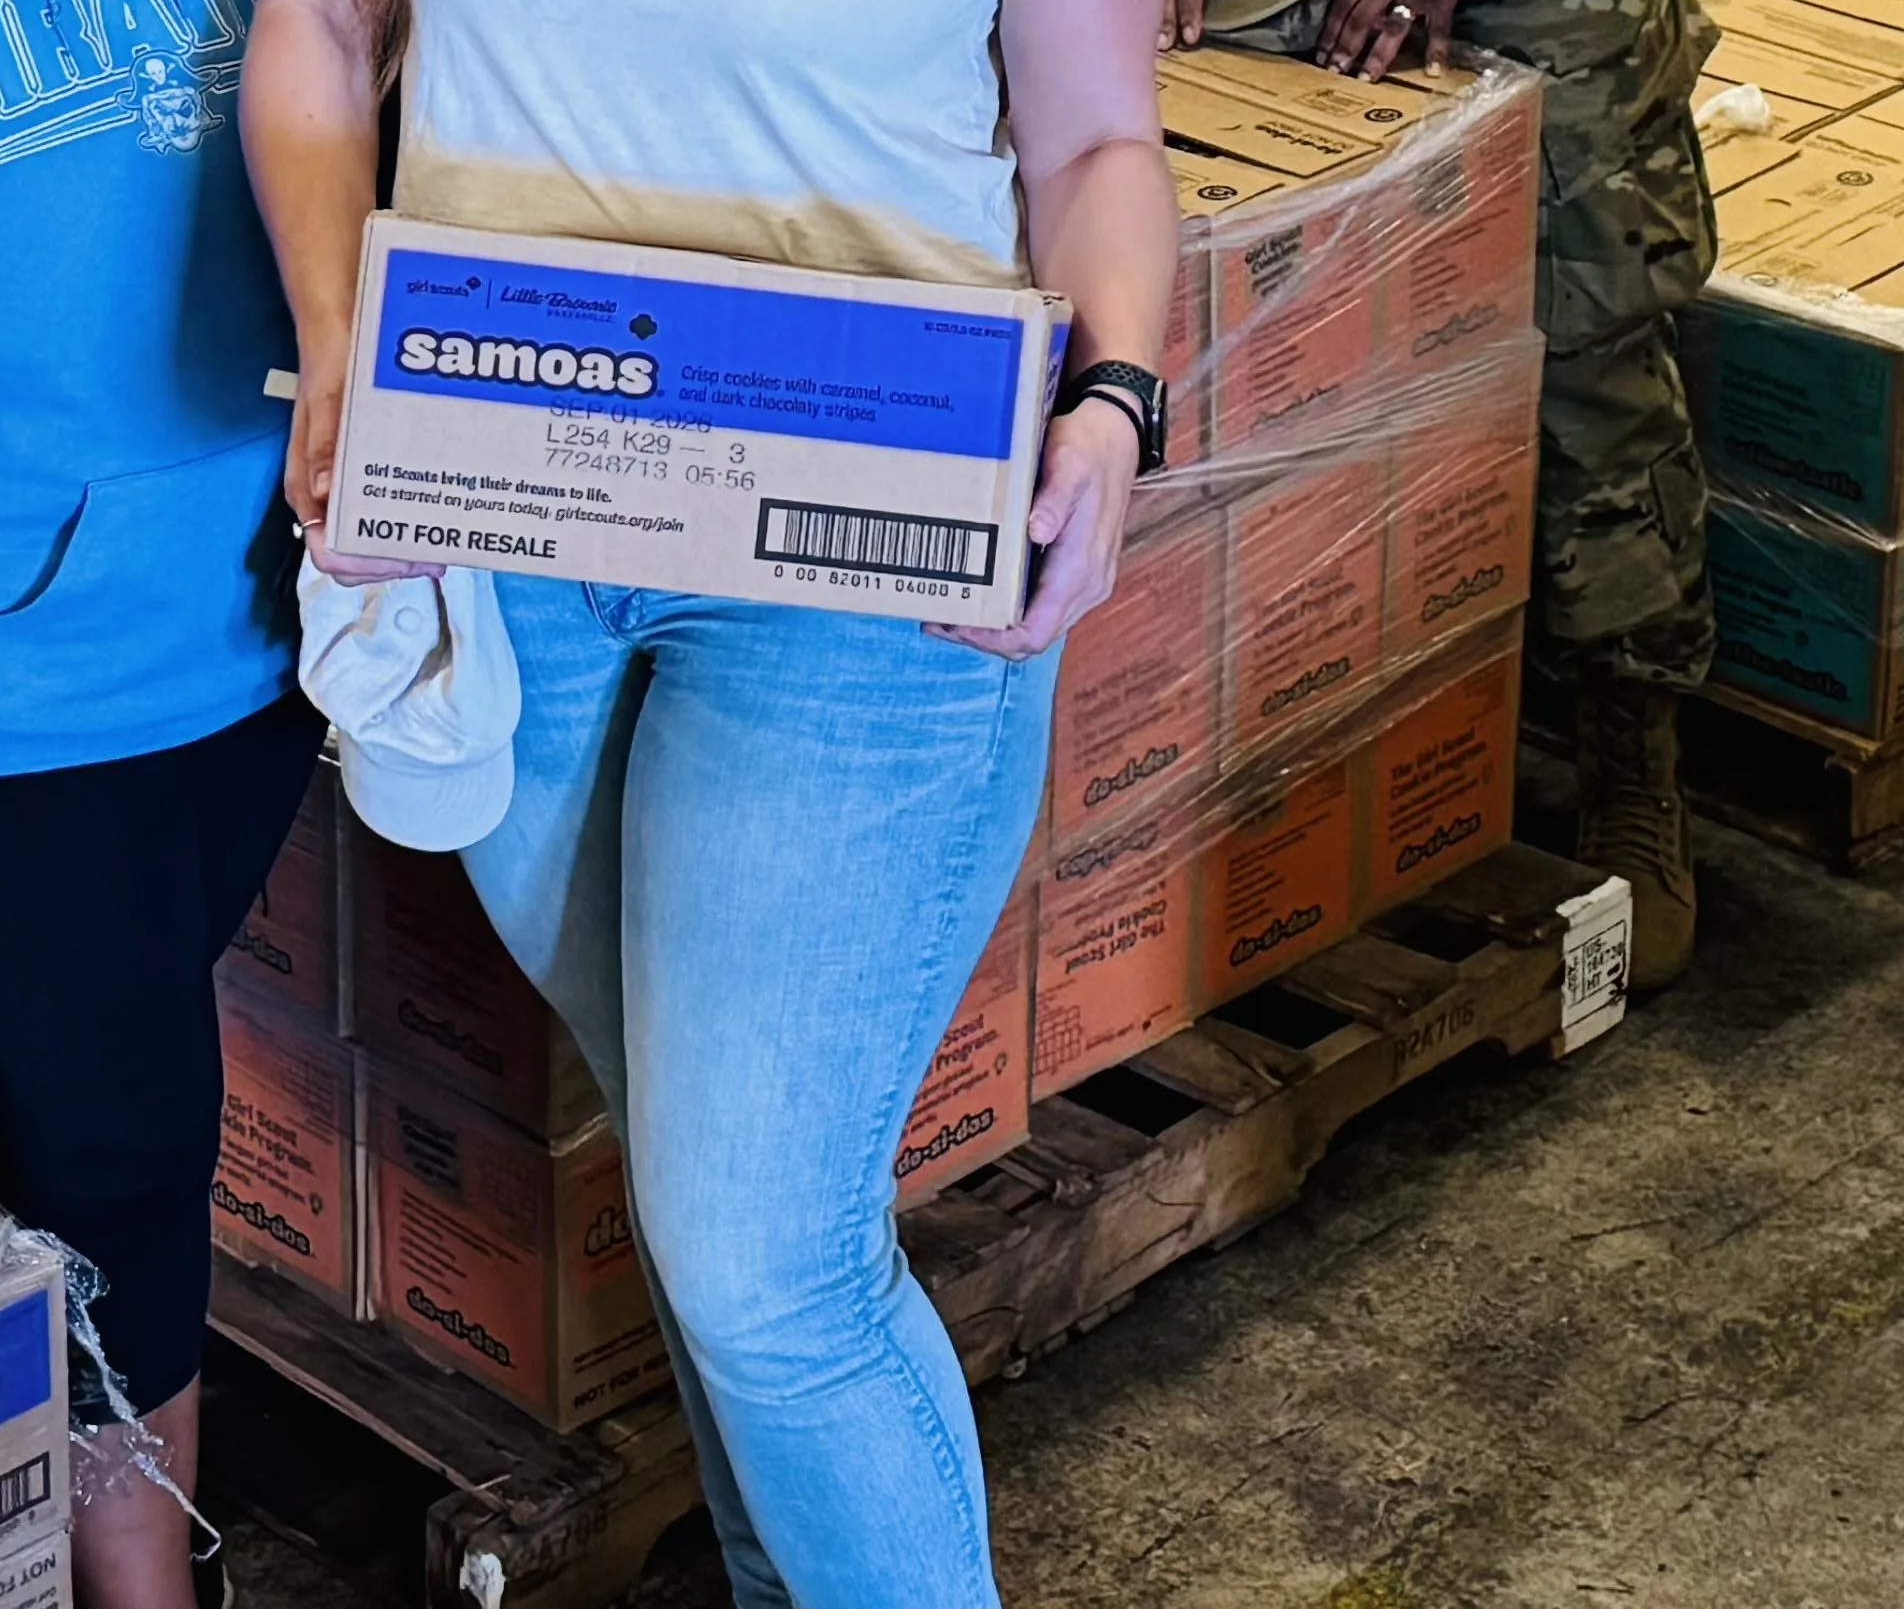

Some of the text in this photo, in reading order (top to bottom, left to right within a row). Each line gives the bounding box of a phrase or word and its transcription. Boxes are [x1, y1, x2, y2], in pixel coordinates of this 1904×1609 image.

[500, 285, 542, 305] Little
[398, 330, 656, 396] samoas
[678, 387, 876, 423] and dark chocolaty stripes
[681, 365, 720, 384] Crisp
[724, 371, 781, 392] cookies
[785, 377, 817, 394] with
[820, 382, 885, 404] caramel,
[549, 397, 599, 419] SEP
[544, 447, 756, 491] 77248713 05:56
[623, 434, 671, 456] K29
[728, 442, 745, 464] 3
[364, 463, 612, 504] Girl Scouts bring their dreams to life.
[362, 483, 386, 499] Get
[390, 487, 441, 506] started
[444, 494, 462, 508] on
[463, 495, 505, 514] yours
[555, 504, 684, 533] girlscouts.org/join
[357, 518, 557, 559] NOT FOR RESALE
[774, 564, 784, 578] 0
[795, 566, 817, 582] 00
[828, 571, 881, 590] 82011
[895, 579, 949, 597] 04000
[1082, 741, 1180, 809] do-si-dos
[1229, 902, 1323, 967] do-si-dos
[895, 1106, 996, 1179] do-si-dos
[211, 1181, 314, 1259] do-si-dos
[406, 1284, 514, 1369] do-si-dos
